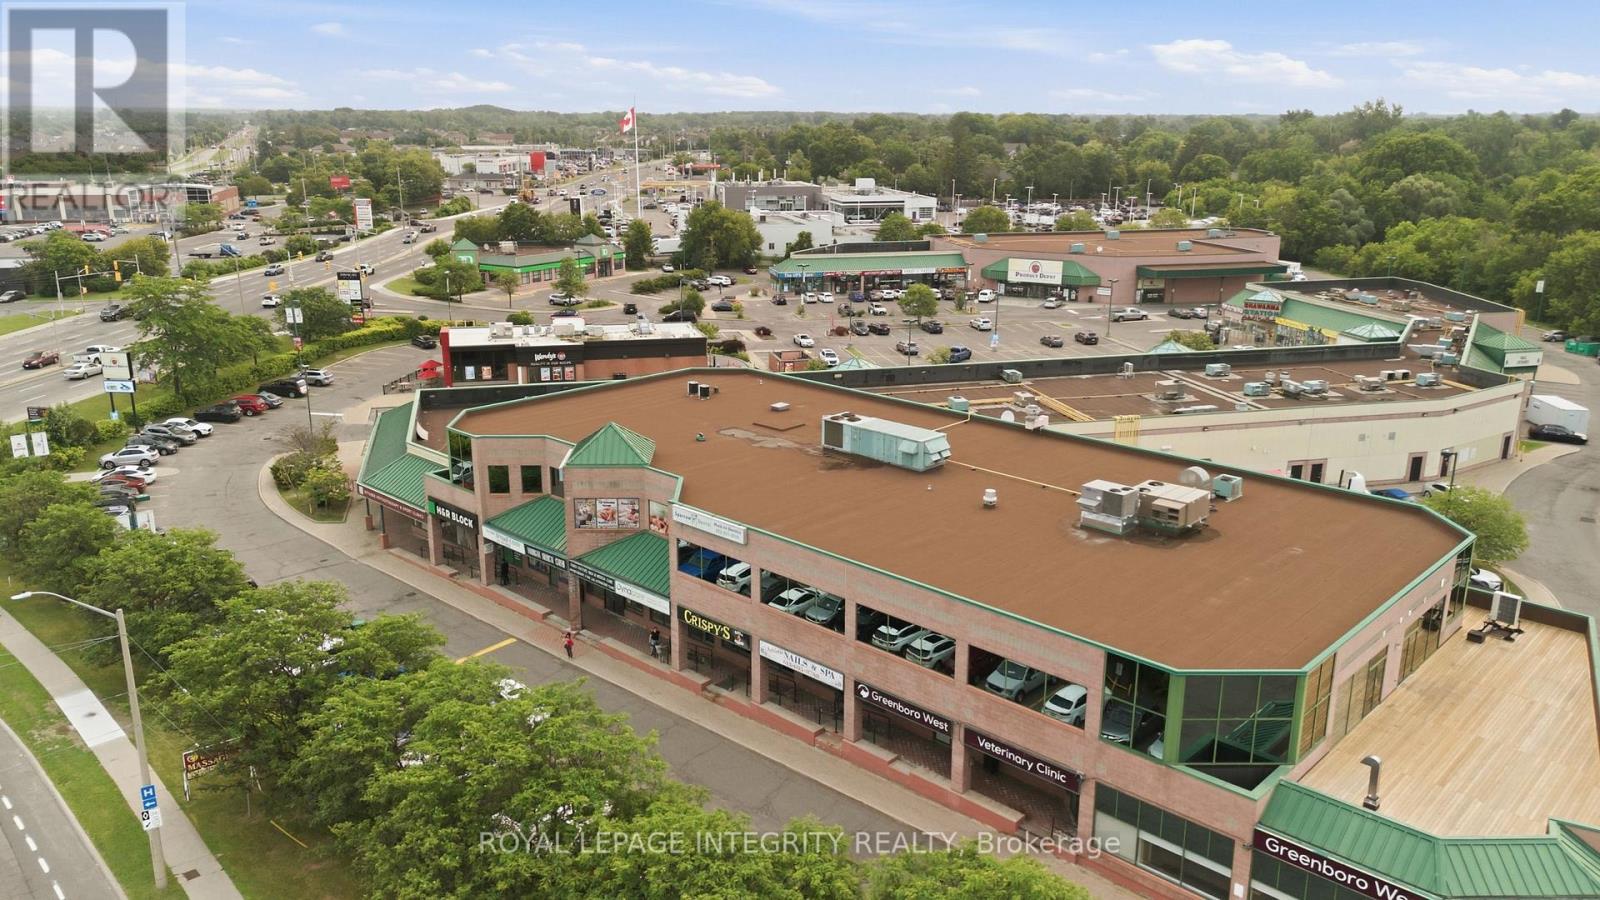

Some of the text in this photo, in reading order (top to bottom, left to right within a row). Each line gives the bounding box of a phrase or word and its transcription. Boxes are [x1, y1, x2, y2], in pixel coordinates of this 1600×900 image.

[436, 505, 474, 529] H&R BLOCK
[684, 609, 731, 641] CRISPY'S
[783, 651, 809, 667] NAILS
[819, 666, 836, 681] SPA
[871, 690, 949, 733] Greenboro West
[977, 735, 1067, 784] Veterinary Clinic
[143, 787, 154, 798] H
[1265, 837, 1369, 890] Greenboro
